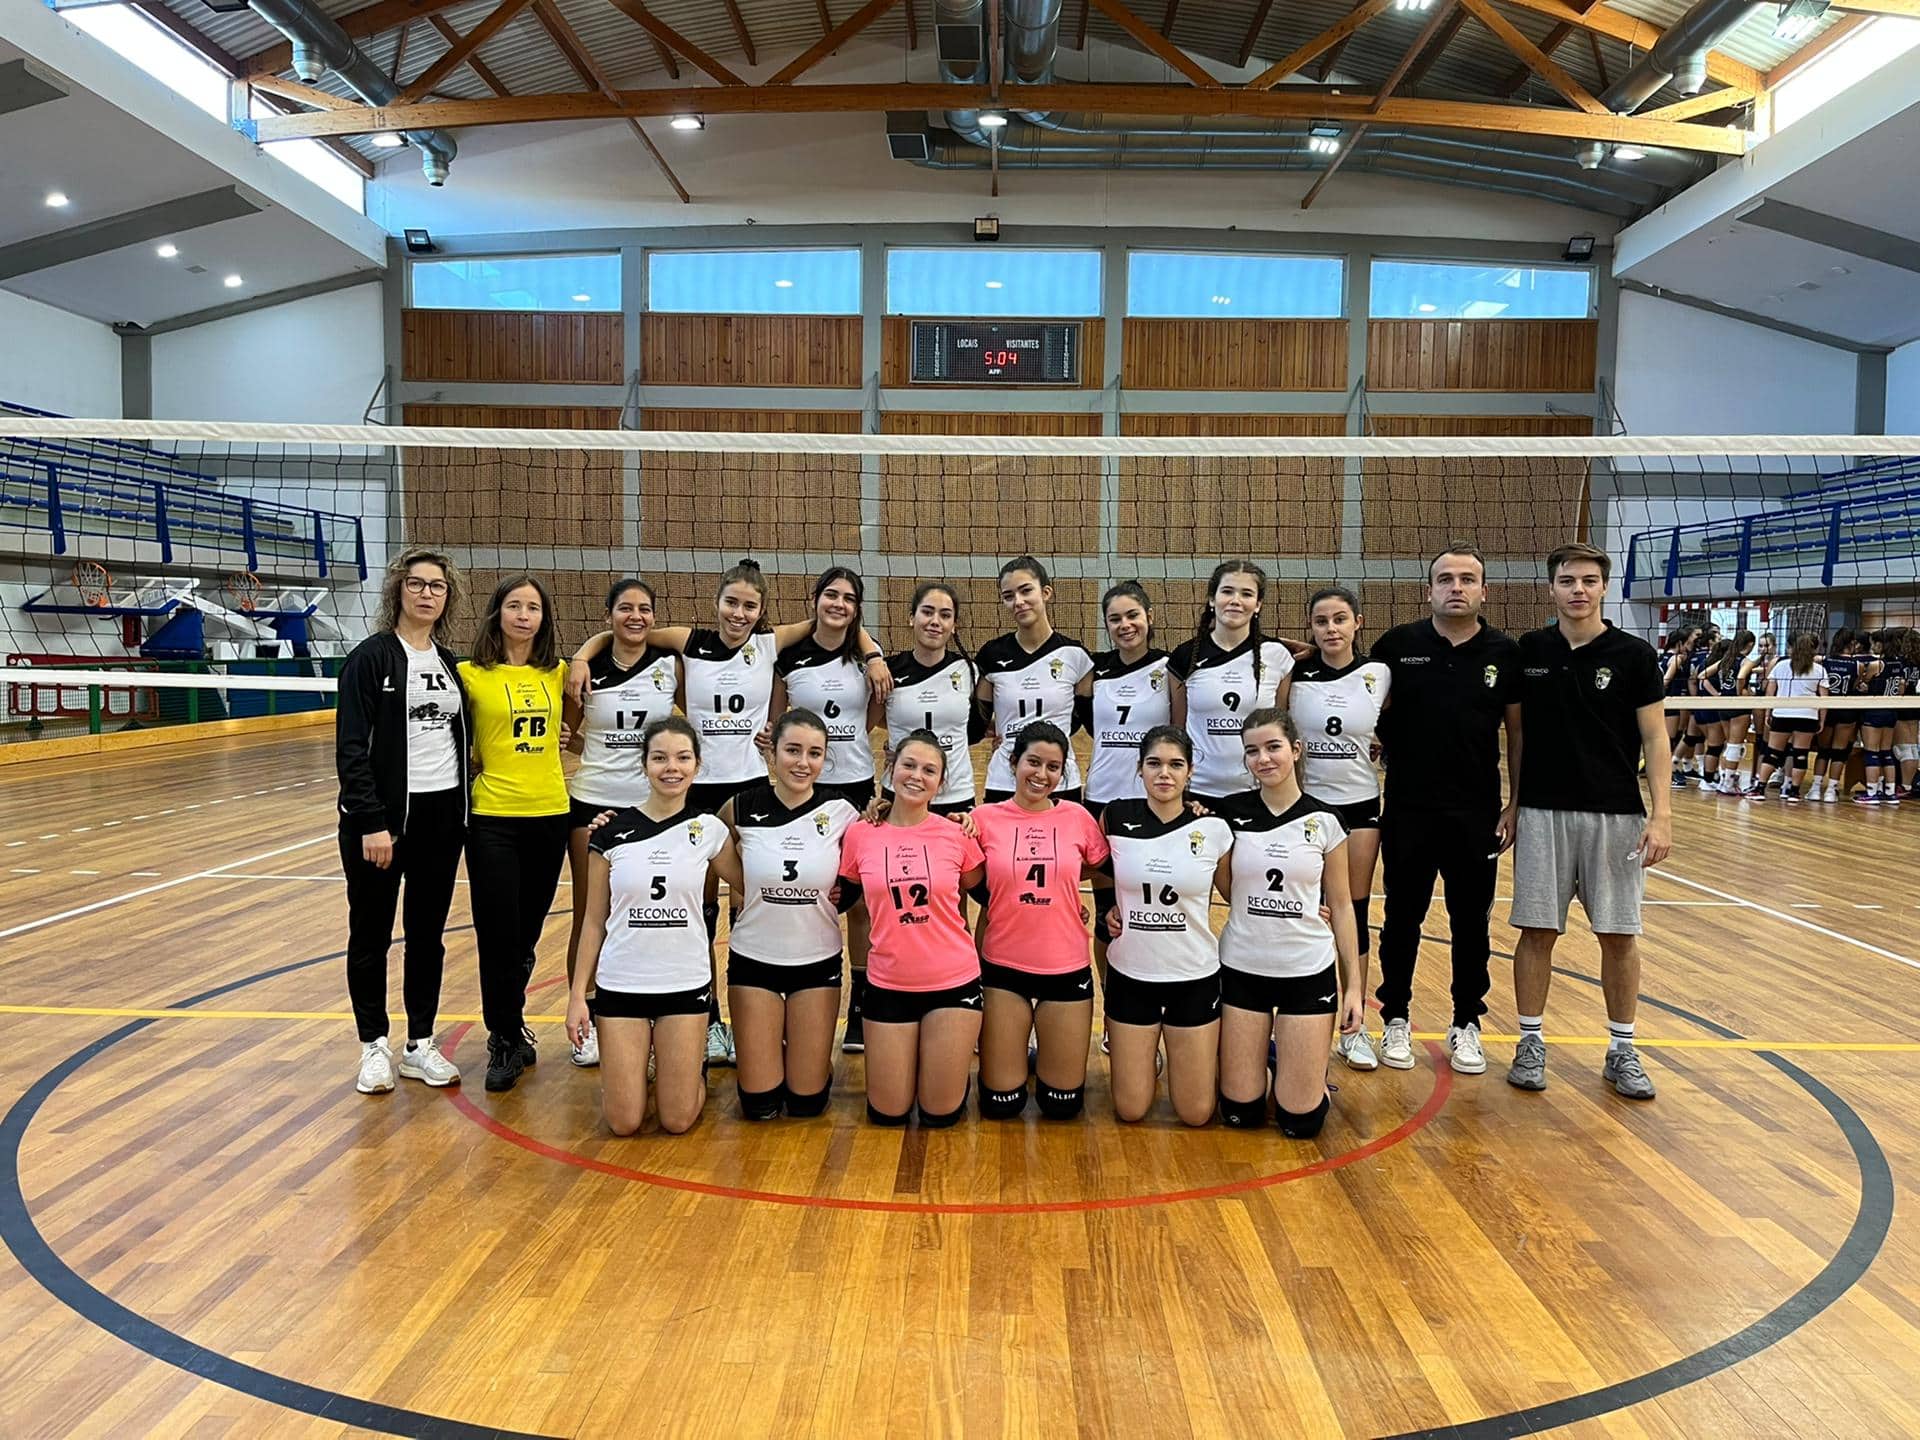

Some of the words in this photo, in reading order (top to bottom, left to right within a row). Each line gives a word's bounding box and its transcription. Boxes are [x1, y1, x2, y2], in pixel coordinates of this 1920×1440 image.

[957, 339, 979, 348] LOCAIS
[1006, 340, 1040, 349] VISITANTES
[1828, 673, 1851, 694] 21
[713, 694, 745, 713] 10
[823, 699, 841, 719] 6
[1018, 698, 1043, 717] 11
[1222, 691, 1241, 712] 9
[616, 711, 648, 730] 17
[702, 719, 752, 729] RECONCO
[925, 712, 932, 730] 1
[1116, 706, 1132, 725] 7
[1207, 718, 1243, 728] RECON
[513, 716, 546, 738] FB
[827, 725, 856, 734] ONCO
[1325, 716, 1342, 737] 8
[605, 733, 647, 742] RECON
[1307, 742, 1358, 752] RECONCO
[782, 860, 799, 882] 3
[1025, 864, 1046, 888] 4
[1266, 868, 1284, 892] 2
[650, 876, 667, 901] 5
[761, 887, 819, 898] RECONCO
[891, 883, 929, 910] 12
[1142, 882, 1179, 906] 16
[1248, 895, 1303, 911] RECONCO
[629, 908, 688, 920] RECONCO
[1130, 910, 1186, 923] RECONCO
[992, 1092, 1019, 1102] ALLSIX
[1048, 1091, 1076, 1100] ALLSIX
